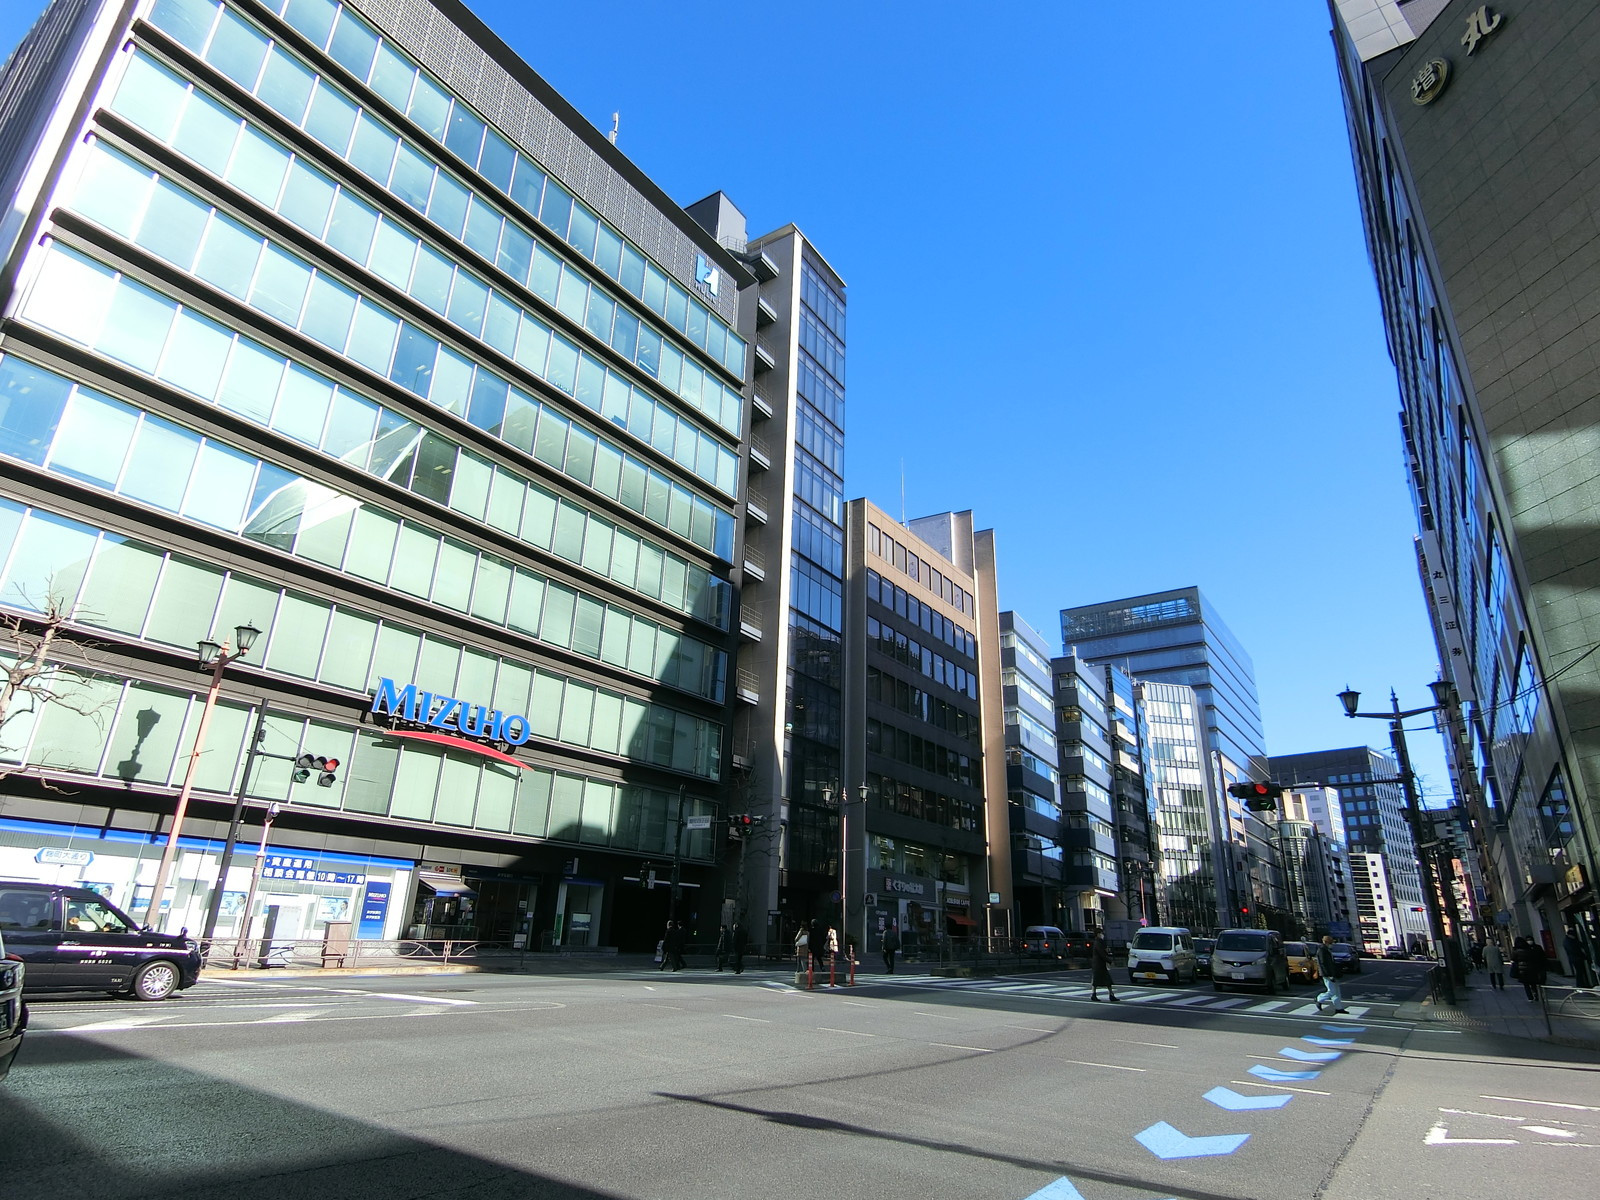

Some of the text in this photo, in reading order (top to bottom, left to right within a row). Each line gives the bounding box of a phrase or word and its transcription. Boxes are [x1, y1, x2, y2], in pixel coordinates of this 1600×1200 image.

[1432, 570, 1463, 657] 丸三証券
[371, 676, 531, 746] MIZUHO
